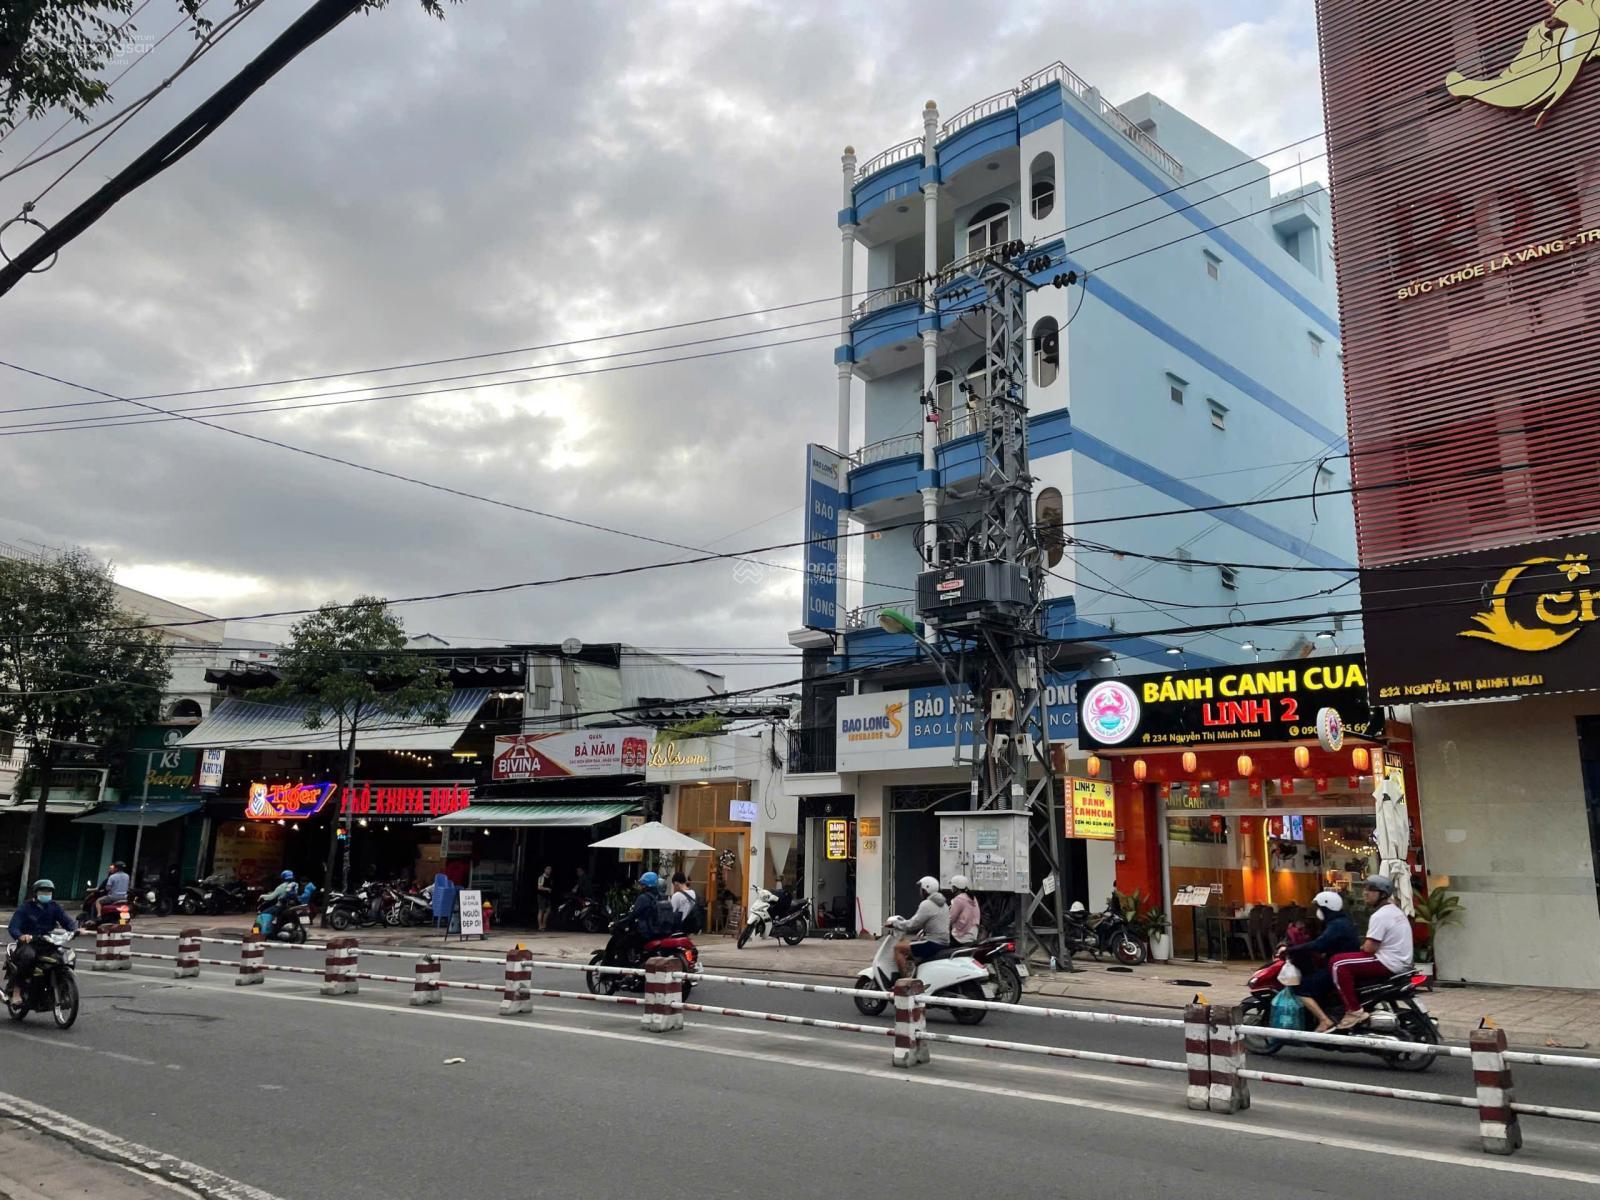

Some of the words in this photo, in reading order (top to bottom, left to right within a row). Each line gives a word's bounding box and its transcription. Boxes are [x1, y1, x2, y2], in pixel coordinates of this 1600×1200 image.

[1398, 279, 1433, 300] SỨC
[1439, 264, 1485, 288] KHỎE
[1490, 253, 1514, 273] LÀ
[1517, 240, 1565, 261] VÀNG
[810, 596, 836, 618] LONG
[1143, 675, 1214, 703] BÁNH
[1219, 670, 1297, 697] CANH
[1303, 664, 1366, 690] CUA
[914, 691, 944, 719] BẢO
[1203, 699, 1272, 726] LINH
[1280, 697, 1300, 722] 2
[841, 719, 861, 732] BAO
[863, 715, 890, 730] LONG
[914, 722, 942, 737] BAO
[1152, 734, 1168, 743] 234
[1202, 731, 1215, 741] Thị
[1218, 730, 1239, 740] Minh
[1241, 729, 1261, 738] Khai
[498, 757, 541, 773] BIVINA
[270, 782, 321, 812] Tiger
[1074, 781, 1091, 792] LINH
[1091, 783, 1096, 793] 2
[376, 786, 424, 814] KHUYA
